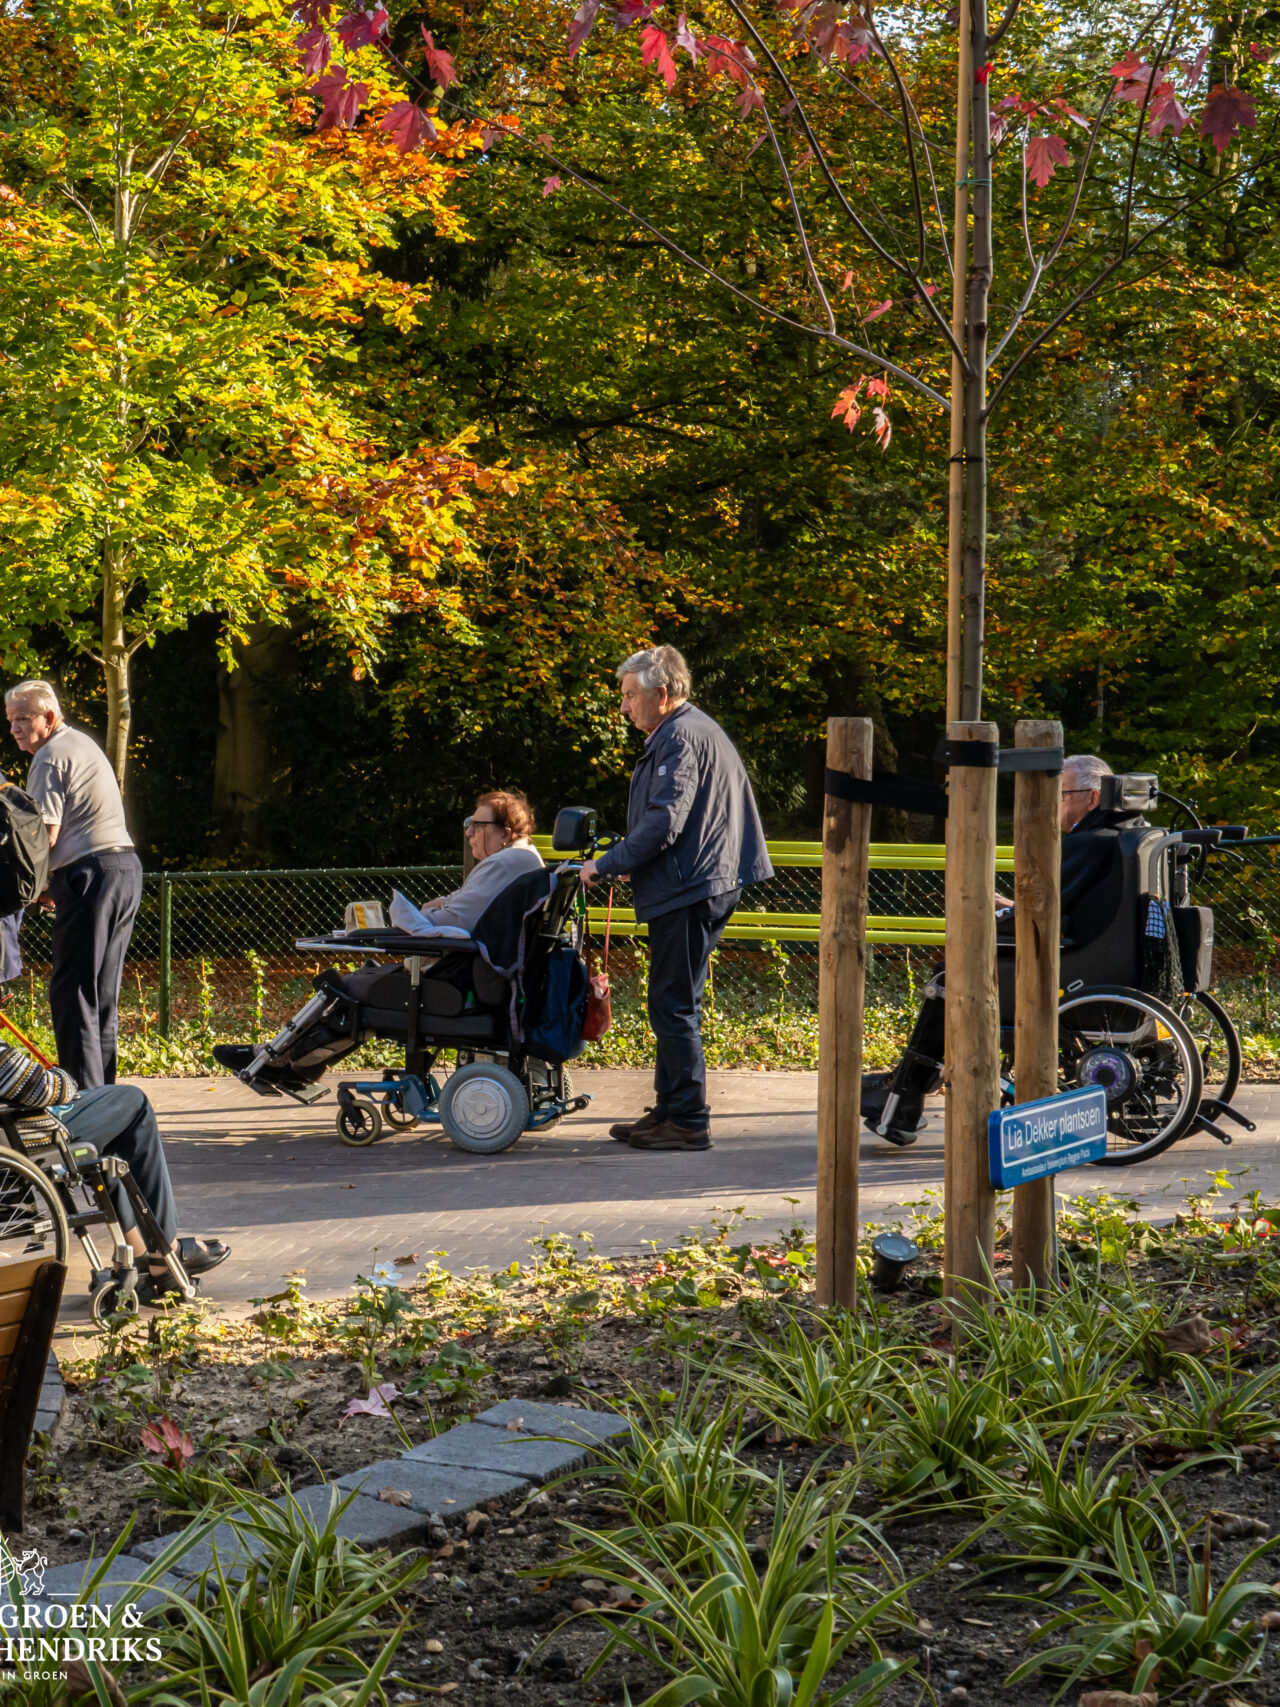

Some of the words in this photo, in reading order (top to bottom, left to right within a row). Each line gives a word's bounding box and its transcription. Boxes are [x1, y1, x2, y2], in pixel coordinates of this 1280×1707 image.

[1008, 1125, 1022, 1150] Lia
[1025, 1118, 1058, 1145] Dekker
[1060, 1107, 1100, 1141] plantsoen
